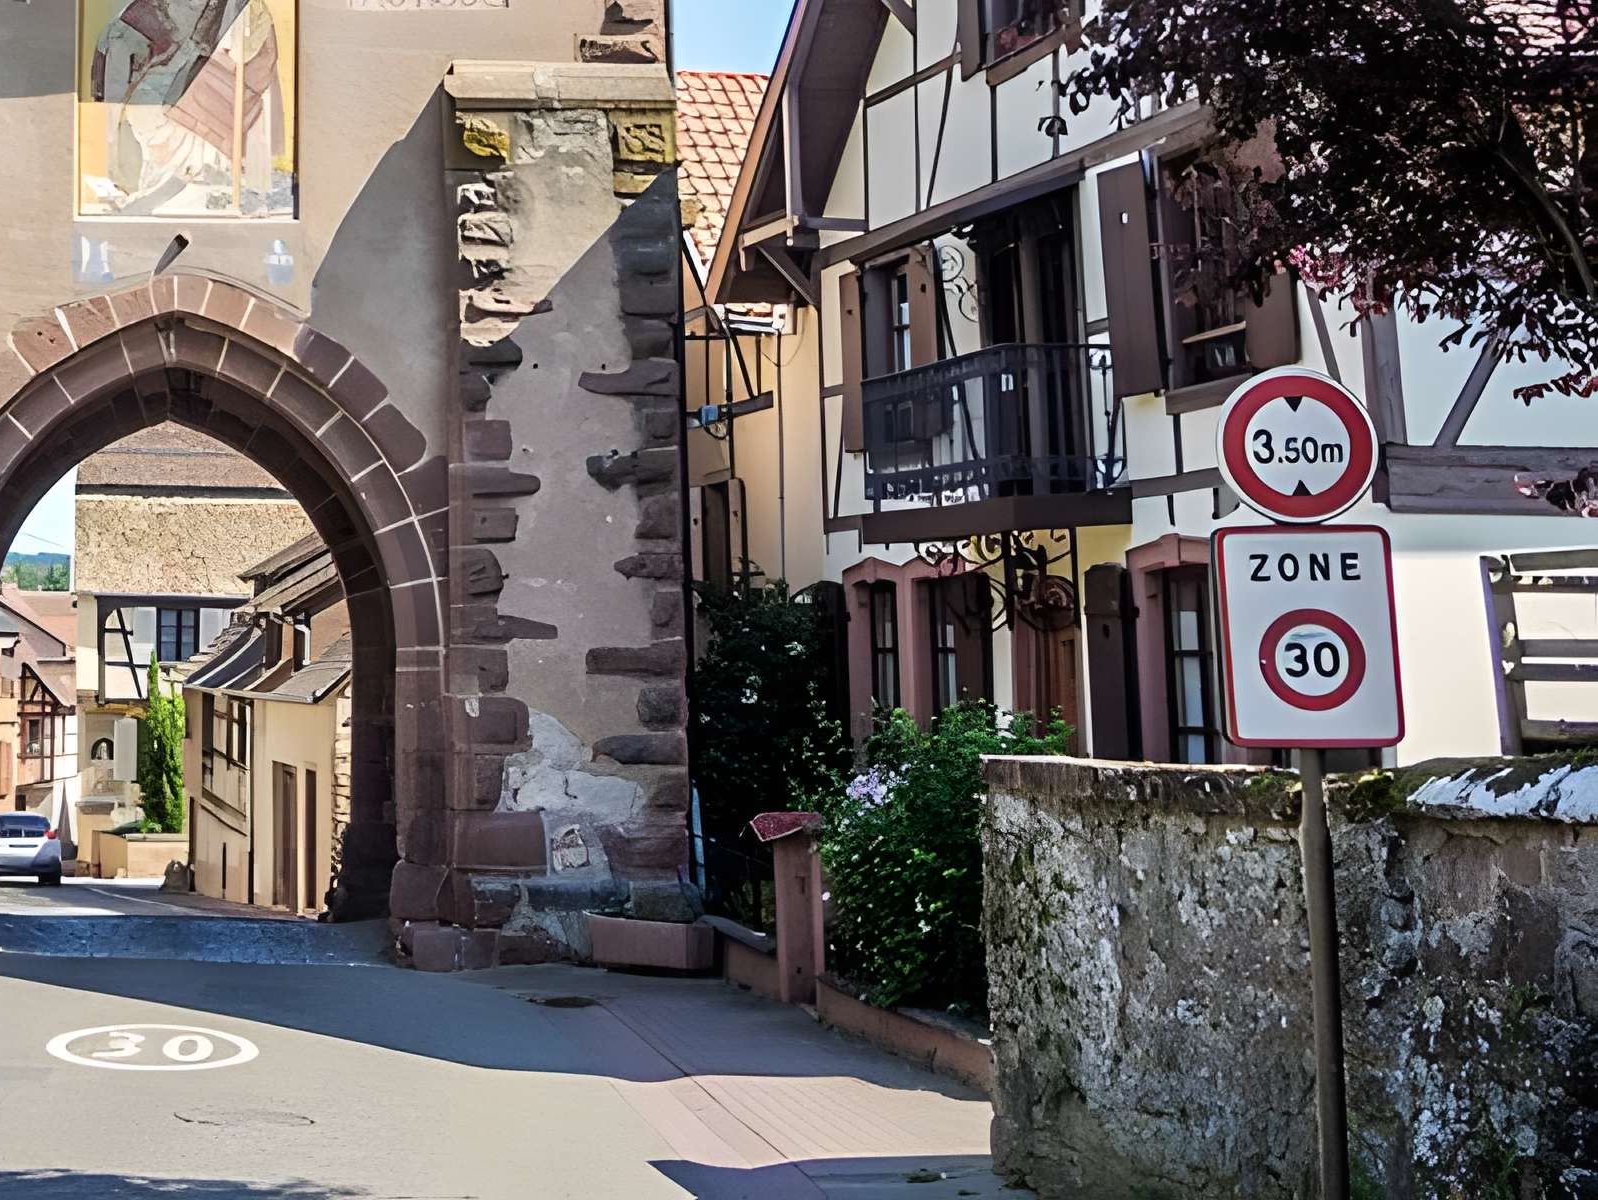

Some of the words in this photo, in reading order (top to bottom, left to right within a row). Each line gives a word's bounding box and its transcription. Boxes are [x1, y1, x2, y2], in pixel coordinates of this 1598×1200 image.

[1252, 428, 1344, 465] 3.50m
[1248, 552, 1361, 582] ZONE
[1284, 641, 1340, 678] 30
[90, 1030, 214, 1063] 30
